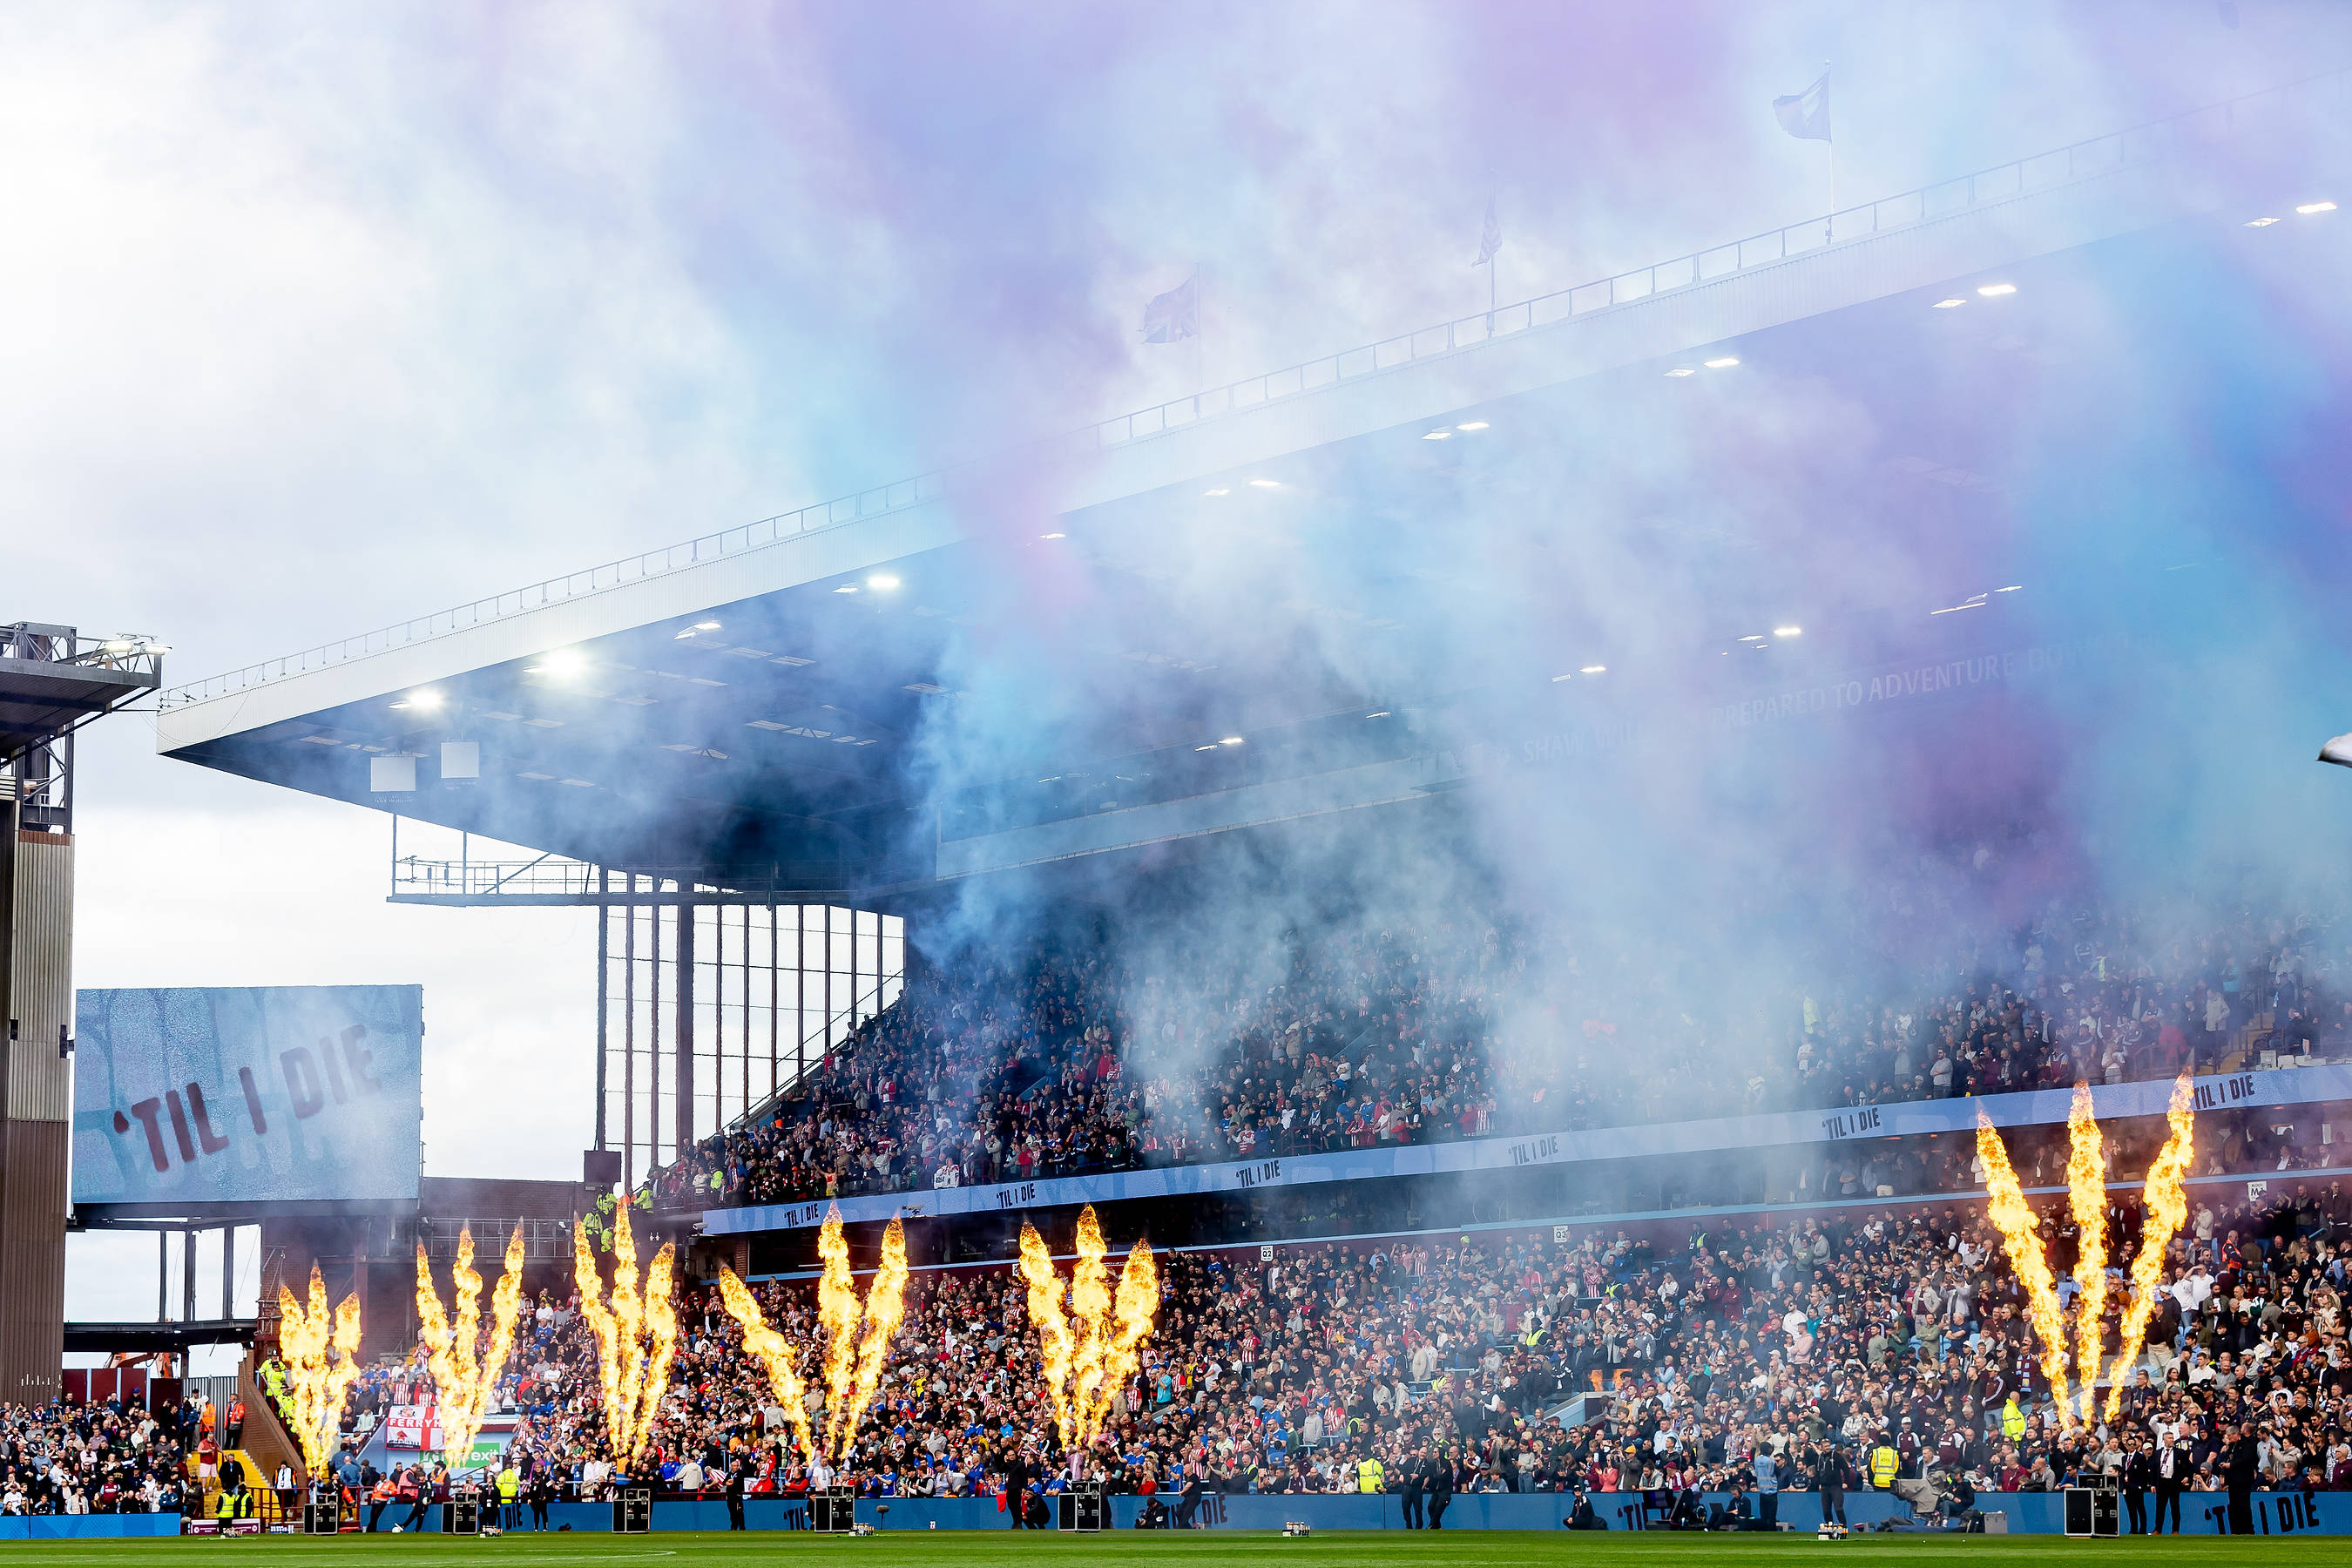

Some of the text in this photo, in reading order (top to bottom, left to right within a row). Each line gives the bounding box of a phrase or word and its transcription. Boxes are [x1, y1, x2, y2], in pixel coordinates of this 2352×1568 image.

[1710, 686, 1825, 730] PREPARED
[1833, 680, 1862, 708] TO
[1869, 652, 2015, 701] ADVENTURE
[113, 1024, 381, 1173] 'TIL I DIE
[2219, 1083, 2225, 1103] I
[2229, 1075, 2254, 1099] DIE
[1822, 1107, 1880, 1139] 'TIL I DIE
[1508, 1135, 1558, 1165] 'TIL I DIE
[1236, 1160, 1281, 1187] 'TIL I DIE
[997, 1183, 1035, 1208] 'TIL I DIE
[784, 1203, 819, 1227] 'TIL I DIE
[471, 1449, 500, 1461] exit
[505, 1503, 523, 1531] DIE
[1201, 1495, 1228, 1525] DIE
[2258, 1501, 2269, 1535] I
[2276, 1491, 2320, 1532] DIE
